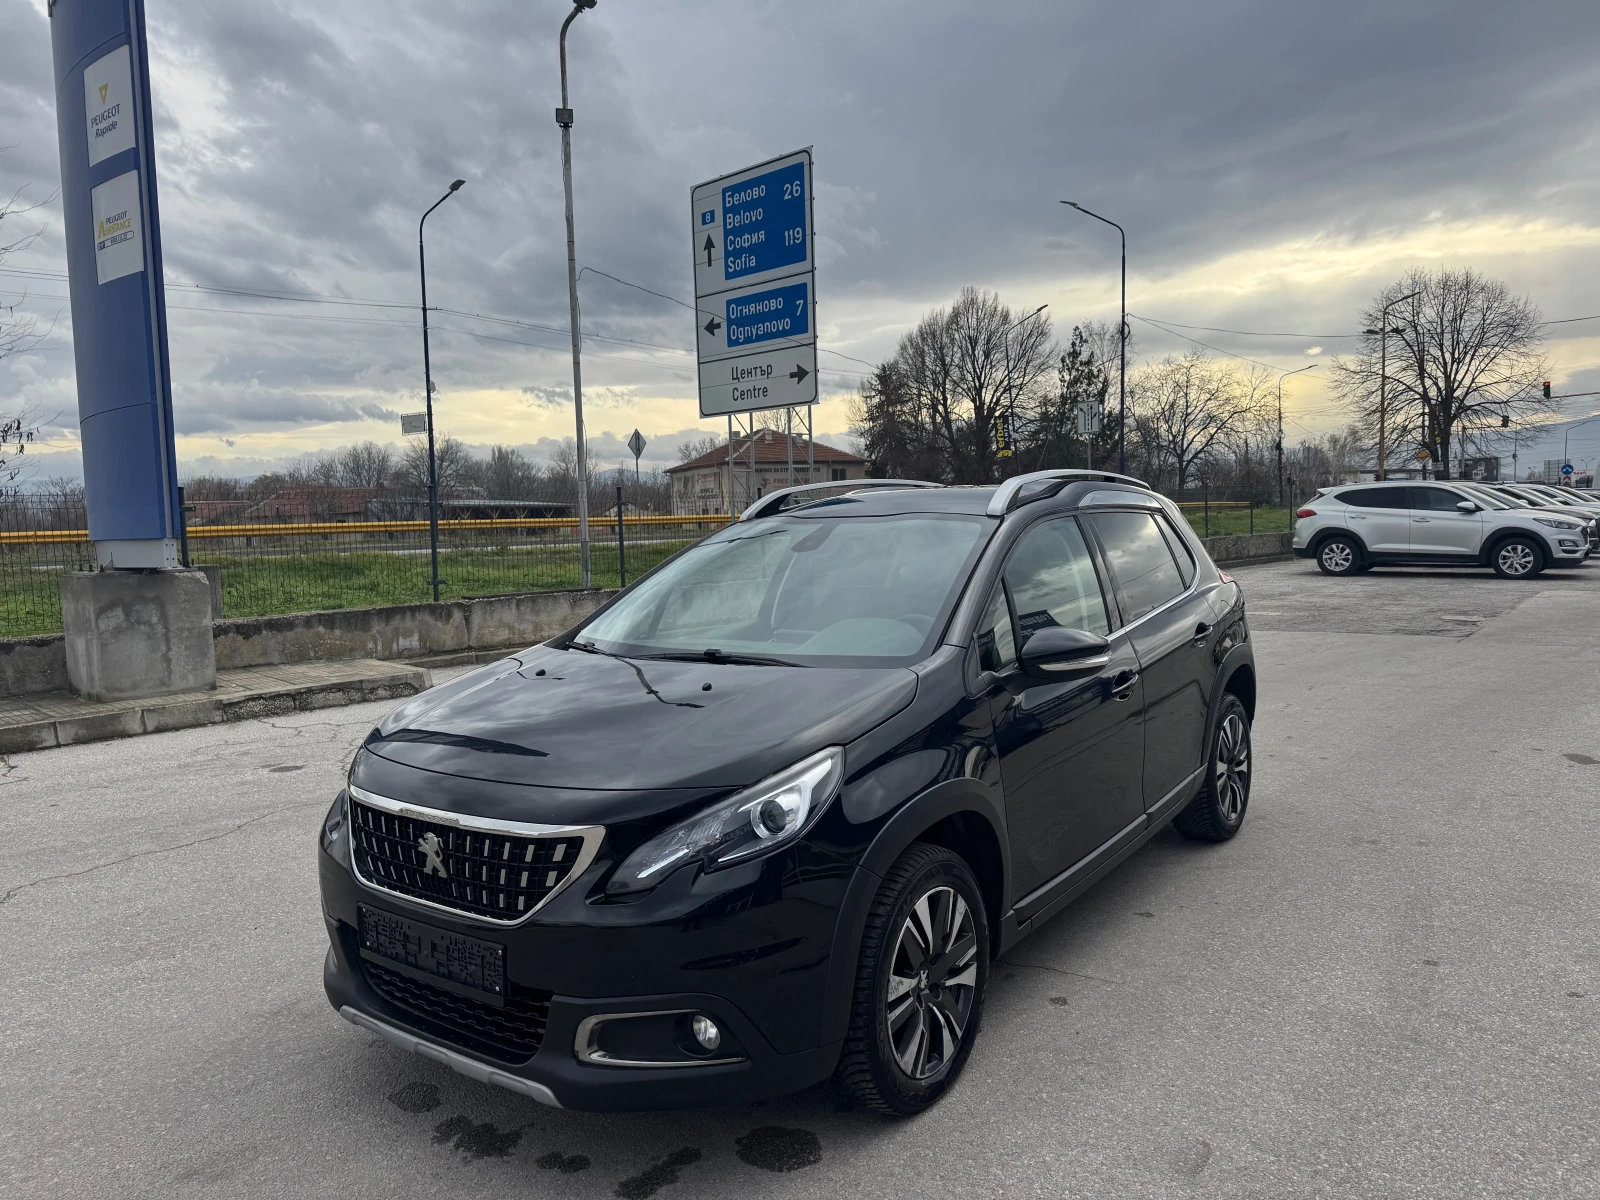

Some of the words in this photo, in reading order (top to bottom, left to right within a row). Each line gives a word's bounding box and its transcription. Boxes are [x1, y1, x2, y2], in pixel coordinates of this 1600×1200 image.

[91, 103, 120, 128] PEUGEOT
[95, 120, 118, 139] Rapide
[725, 185, 766, 207] Белово
[783, 181, 801, 200] 26
[105, 211, 127, 225] PEUGEOT
[705, 212, 711, 223] 8
[726, 208, 764, 229] Belovo
[727, 230, 765, 251] София
[784, 227, 803, 246] 119
[727, 254, 756, 272] Sofia
[729, 297, 783, 319] Огняново
[795, 299, 804, 316] 7
[730, 318, 791, 342] Ognyanovo
[731, 364, 773, 383] Център
[732, 385, 768, 401] Centre
